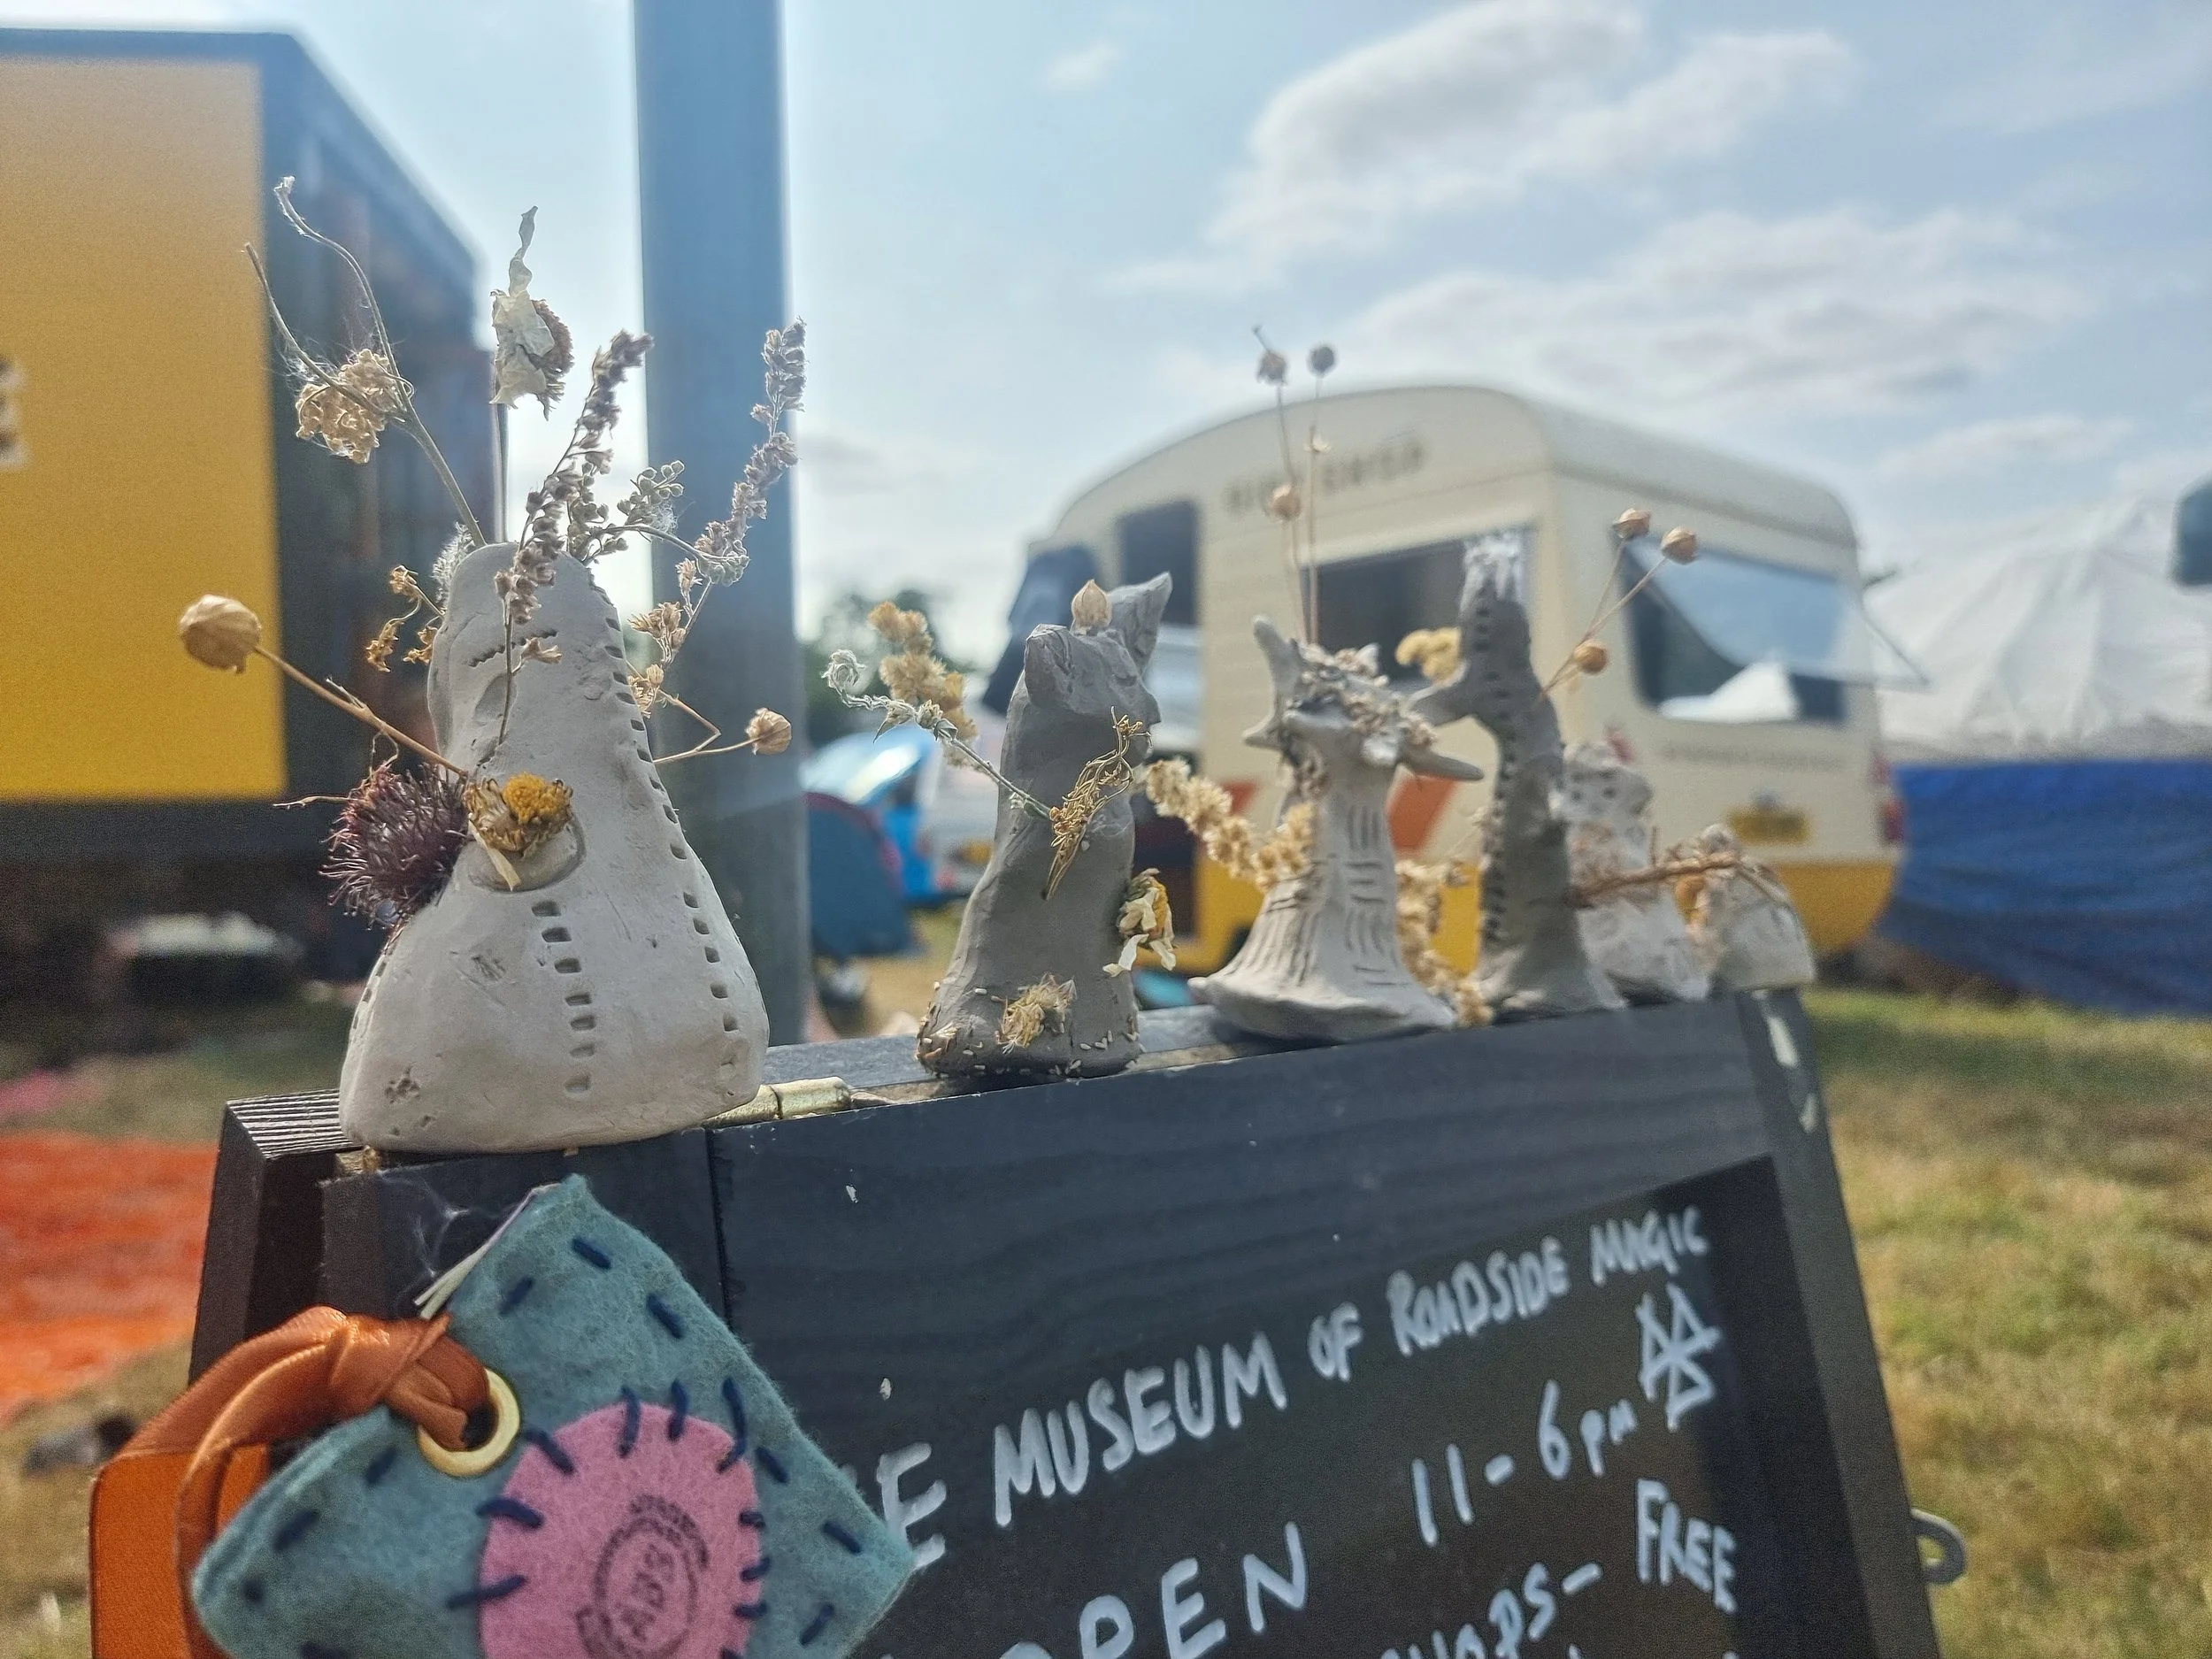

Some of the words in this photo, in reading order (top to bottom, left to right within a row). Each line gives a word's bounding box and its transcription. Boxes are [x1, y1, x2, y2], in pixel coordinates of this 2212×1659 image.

[993, 1332, 1287, 1527] MUSEUM
[1307, 1301, 1363, 1382] OF
[1386, 1234, 1571, 1356] ROADSIDE
[1590, 1204, 1710, 1286] MAGIC
[998, 1520, 1310, 1659] PEN
[1635, 1477, 1737, 1614] FREE
